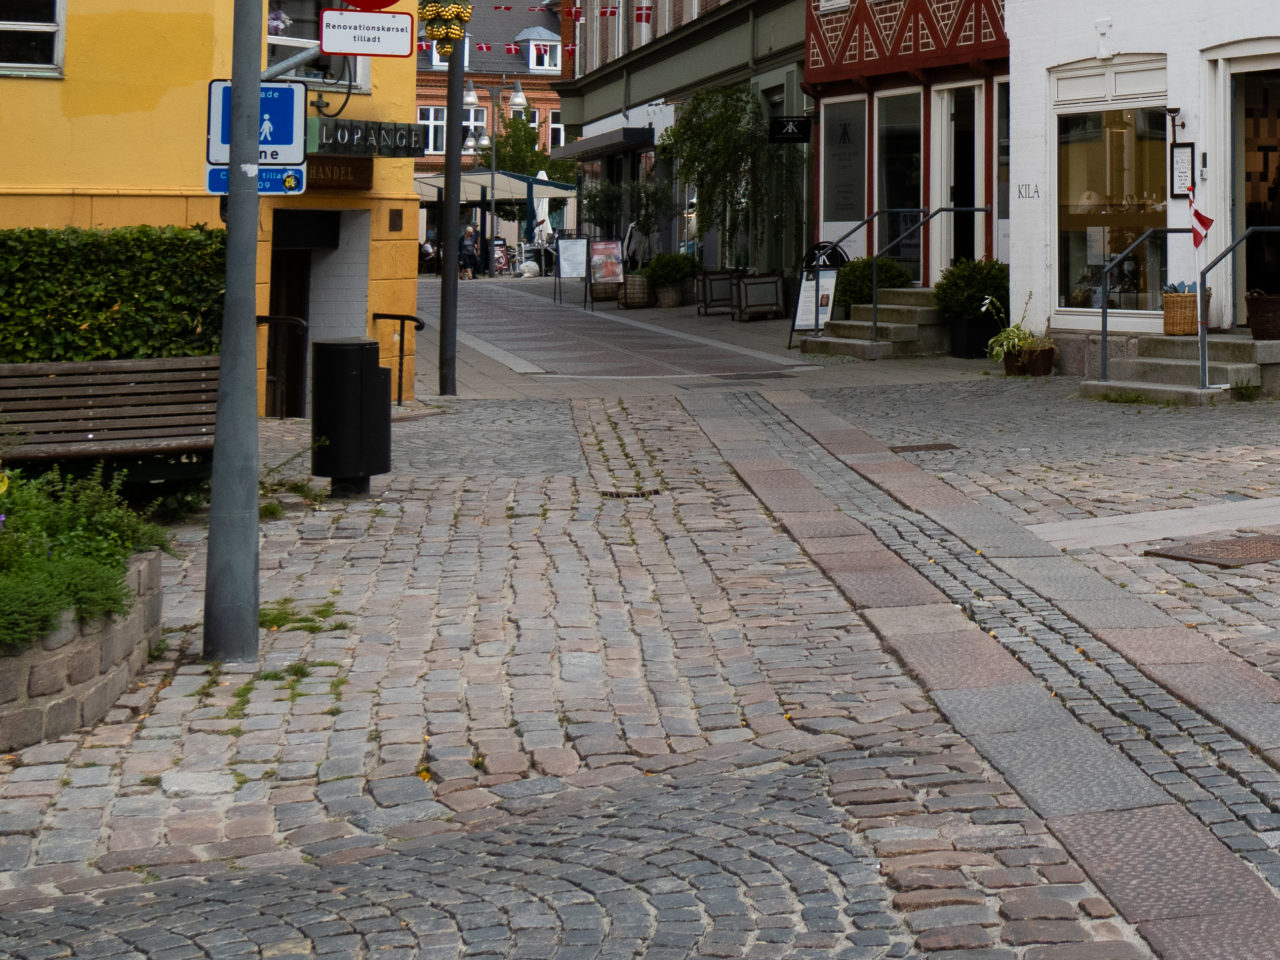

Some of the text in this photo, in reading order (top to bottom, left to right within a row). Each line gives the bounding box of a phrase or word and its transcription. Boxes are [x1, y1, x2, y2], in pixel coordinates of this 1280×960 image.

[325, 22, 408, 33] Renovationskørsel
[353, 35, 381, 43] tilladt
[260, 90, 280, 98] ade
[322, 126, 420, 148] LOPANGE
[260, 149, 279, 160] ne
[1017, 183, 1041, 199] KILA
